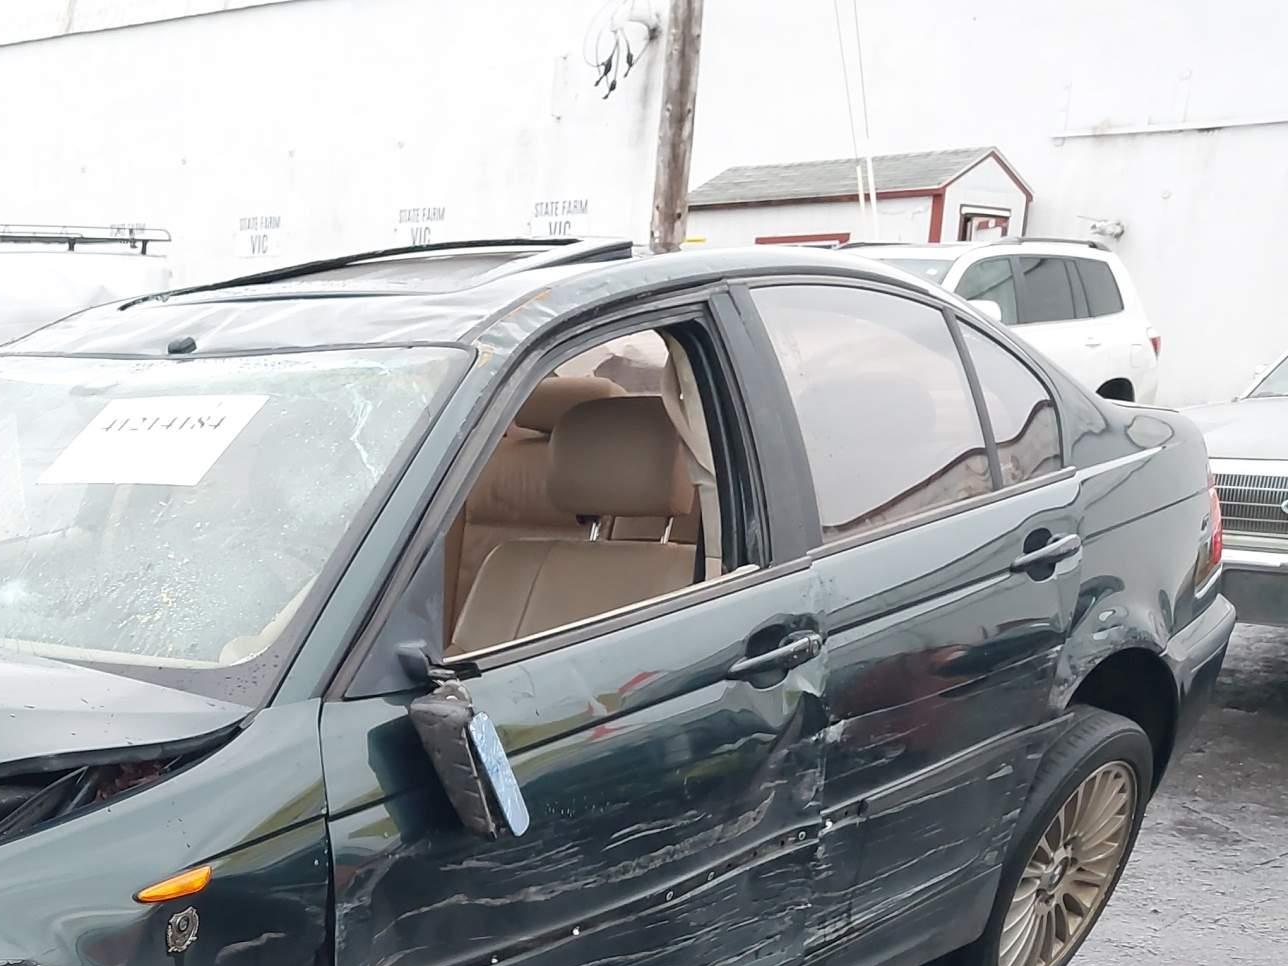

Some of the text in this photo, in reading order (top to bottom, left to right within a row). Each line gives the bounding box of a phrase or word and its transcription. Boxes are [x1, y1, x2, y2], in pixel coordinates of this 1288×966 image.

[398, 206, 446, 224] STATE FARM
[534, 199, 589, 218] STATE FARM
[239, 216, 259, 232] STATE
[250, 233, 269, 254] VIC
[410, 226, 432, 246] VIC
